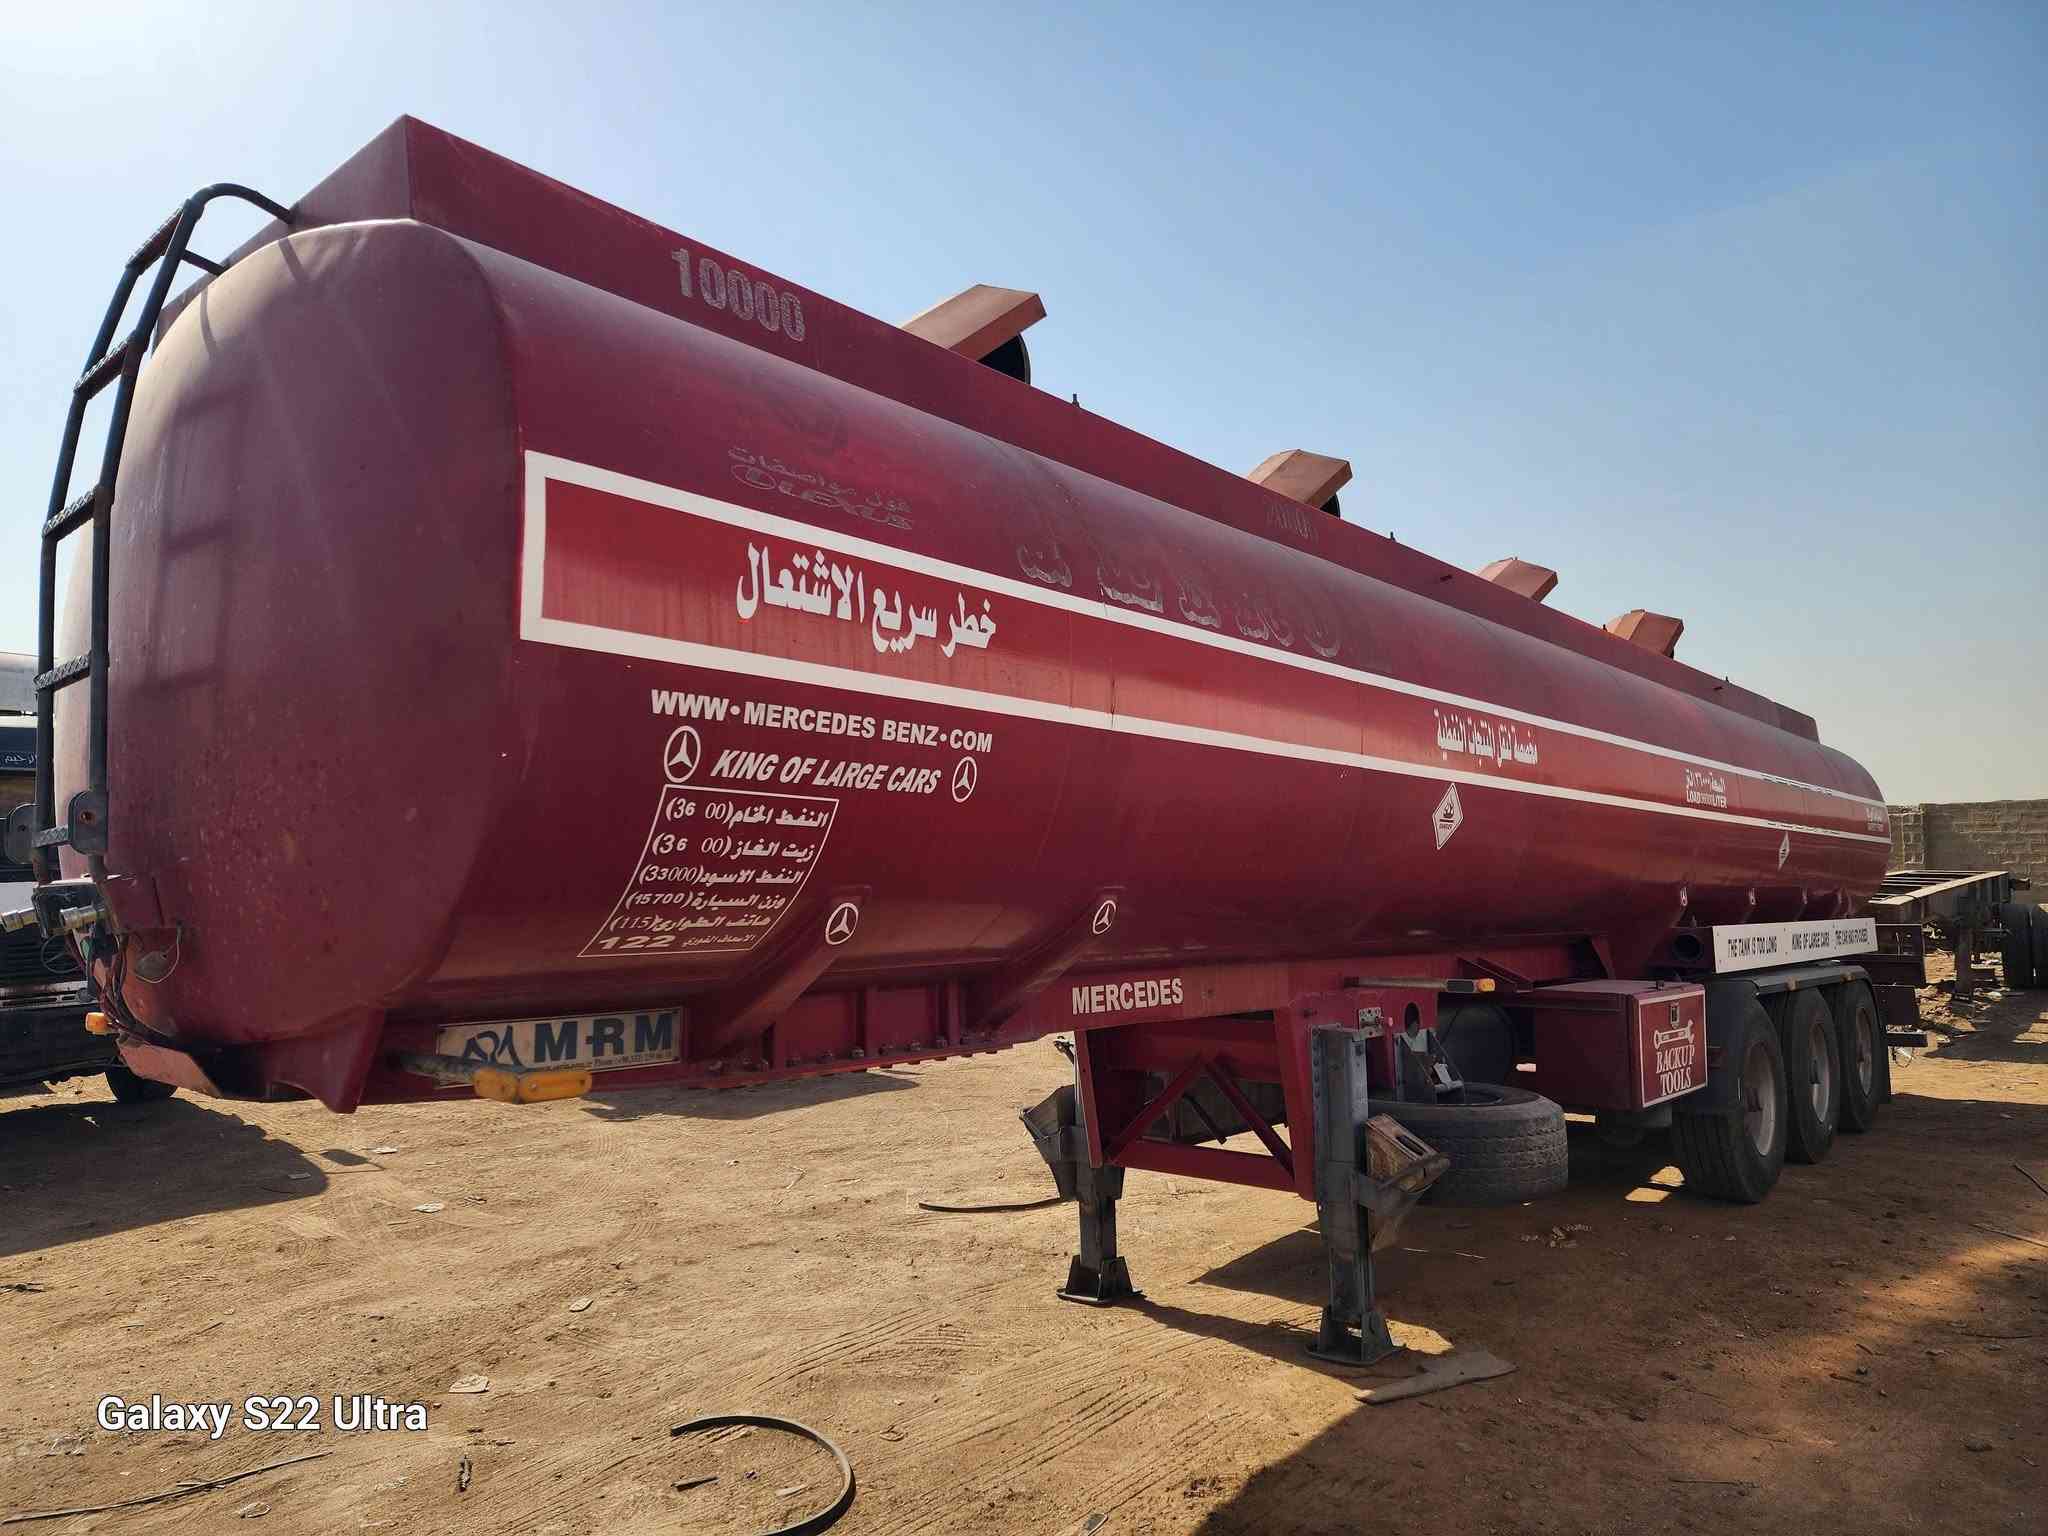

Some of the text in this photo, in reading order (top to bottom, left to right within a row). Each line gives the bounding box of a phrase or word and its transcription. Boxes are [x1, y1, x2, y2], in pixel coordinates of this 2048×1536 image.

[672, 248, 806, 342] 10000
[736, 543, 865, 625] الاشتعال
[872, 588, 938, 653] سريع
[940, 592, 997, 658] خطر
[710, 750, 942, 795] KING OF LARGE CARS
[775, 807, 830, 829] النفط
[731, 838, 781, 860] الغاز
[781, 842, 815, 863] زيت
[755, 867, 805, 885] النفط
[599, 934, 676, 950] 122
[1072, 978, 1184, 1015] MERCEDES
[1656, 1044, 1696, 1074] BACKUP
[1660, 1067, 1692, 1097] TOOLS
